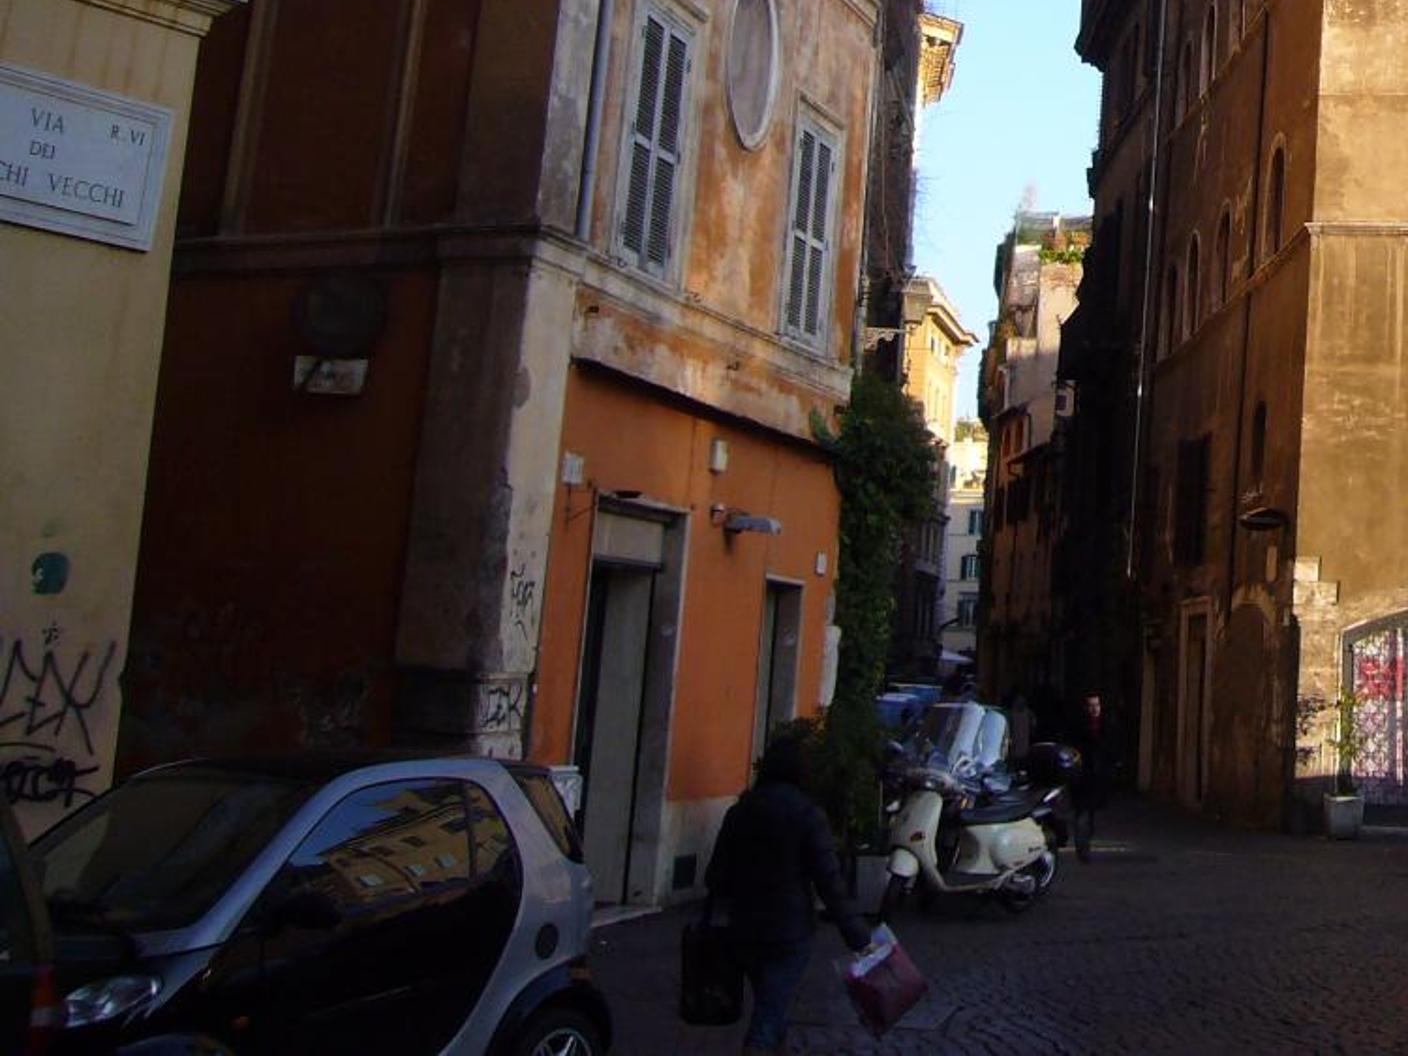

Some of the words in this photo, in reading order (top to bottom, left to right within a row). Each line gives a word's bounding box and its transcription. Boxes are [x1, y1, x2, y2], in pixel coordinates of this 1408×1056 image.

[31, 108, 64, 134] VIA
[130, 129, 145, 145] VI
[29, 141, 56, 159] DEI
[48, 173, 125, 207] VECCHI
